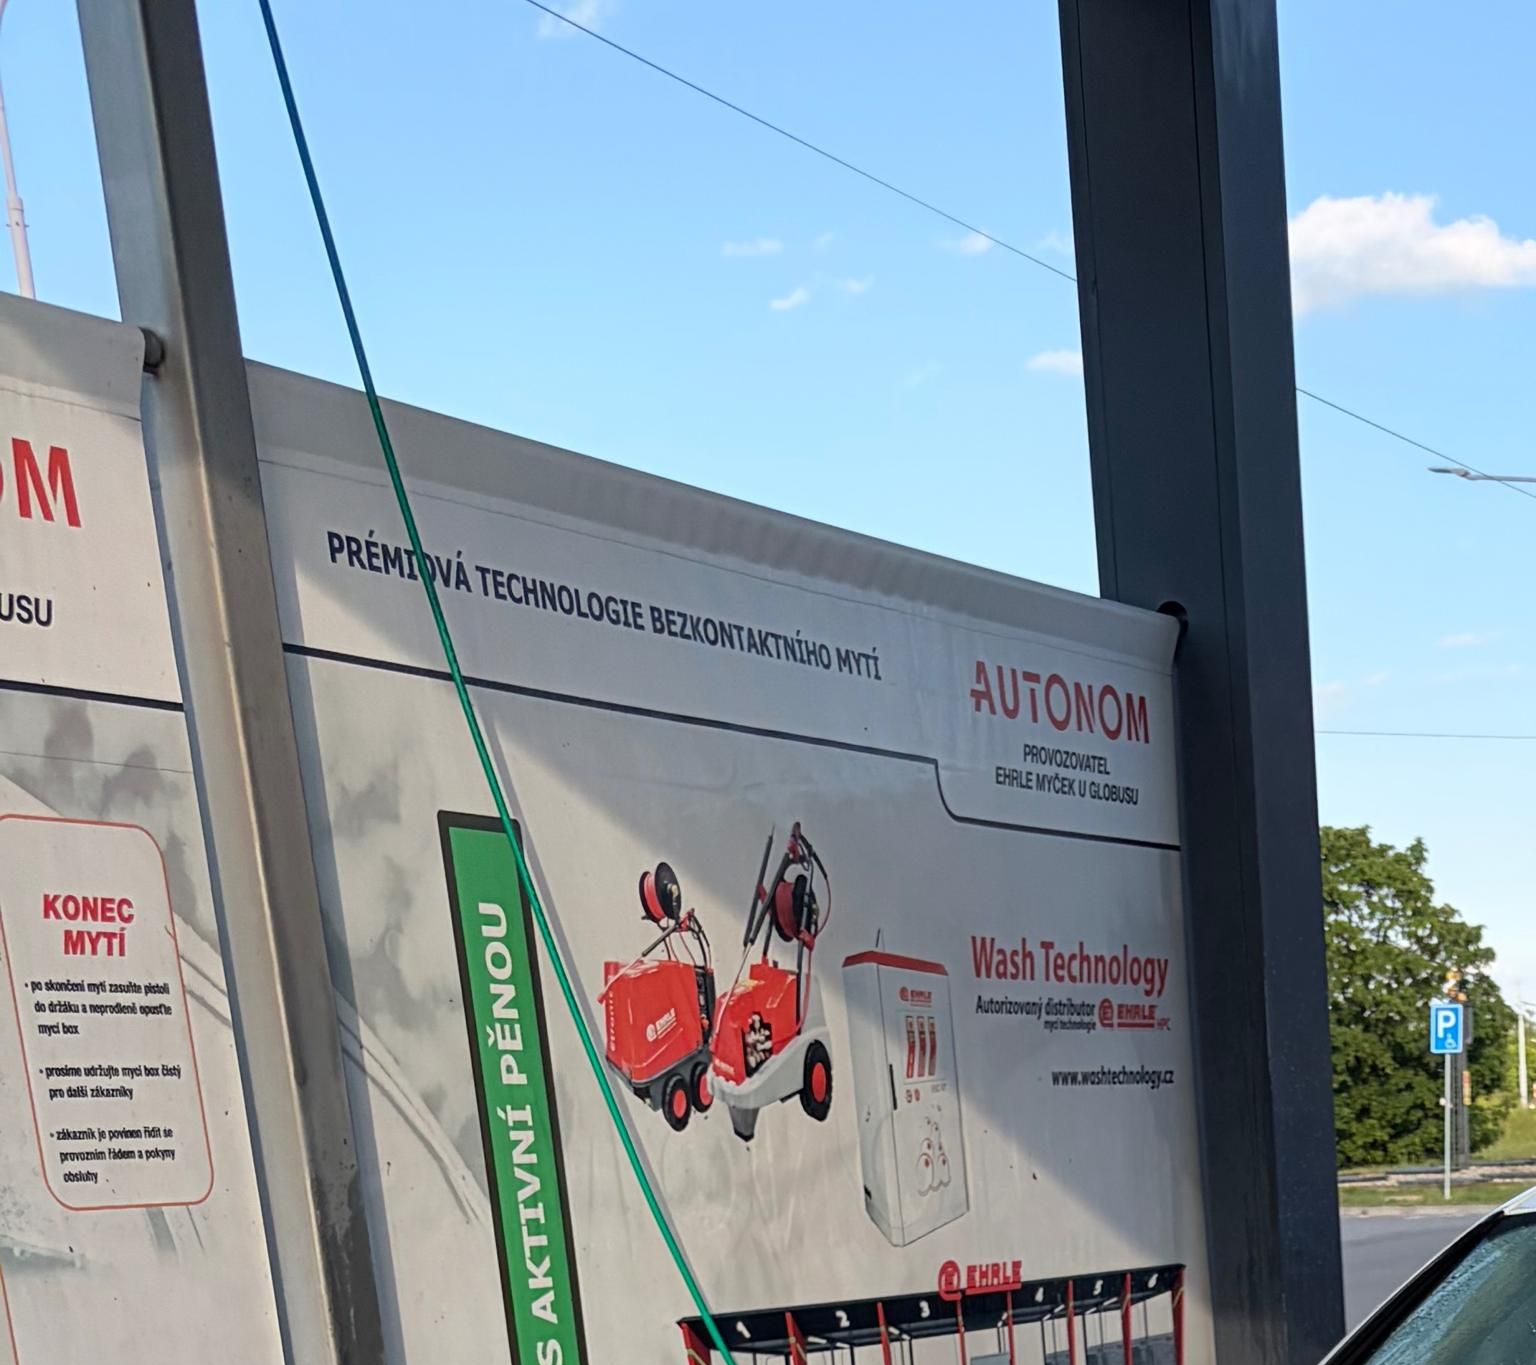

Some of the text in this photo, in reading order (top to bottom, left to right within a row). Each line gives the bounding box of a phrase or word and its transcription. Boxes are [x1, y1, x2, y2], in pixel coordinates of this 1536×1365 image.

[0, 436, 82, 528] M
[475, 564, 645, 631] TECHNOLOGIE
[649, 604, 832, 671] BEZKONTAKTNÍHO
[835, 646, 882, 681] MYTÍ
[970, 660, 1150, 744] AUTONOM
[1023, 744, 1111, 776] PROVOZOVATEL
[995, 766, 1139, 806] EHRLE MYČEK U GLOBUSU
[43, 893, 135, 923] KONEC
[63, 926, 127, 957] MYTÍ
[970, 935, 1169, 998] Wash Technology
[478, 901, 528, 1086] PĚNOU
[976, 995, 1042, 1020] Autorizovaný
[1044, 997, 1096, 1017] distributor
[61, 1023, 79, 1035] box
[1437, 1010, 1456, 1038] P
[1052, 1065, 1174, 1089] www.washtechnology.cz
[49, 1088, 64, 1100] pro
[496, 1103, 558, 1325] AKTIVNÍ
[967, 1260, 1022, 1287] EHRLE
[835, 1310, 850, 1328] 2
[919, 1300, 931, 1318] 3
